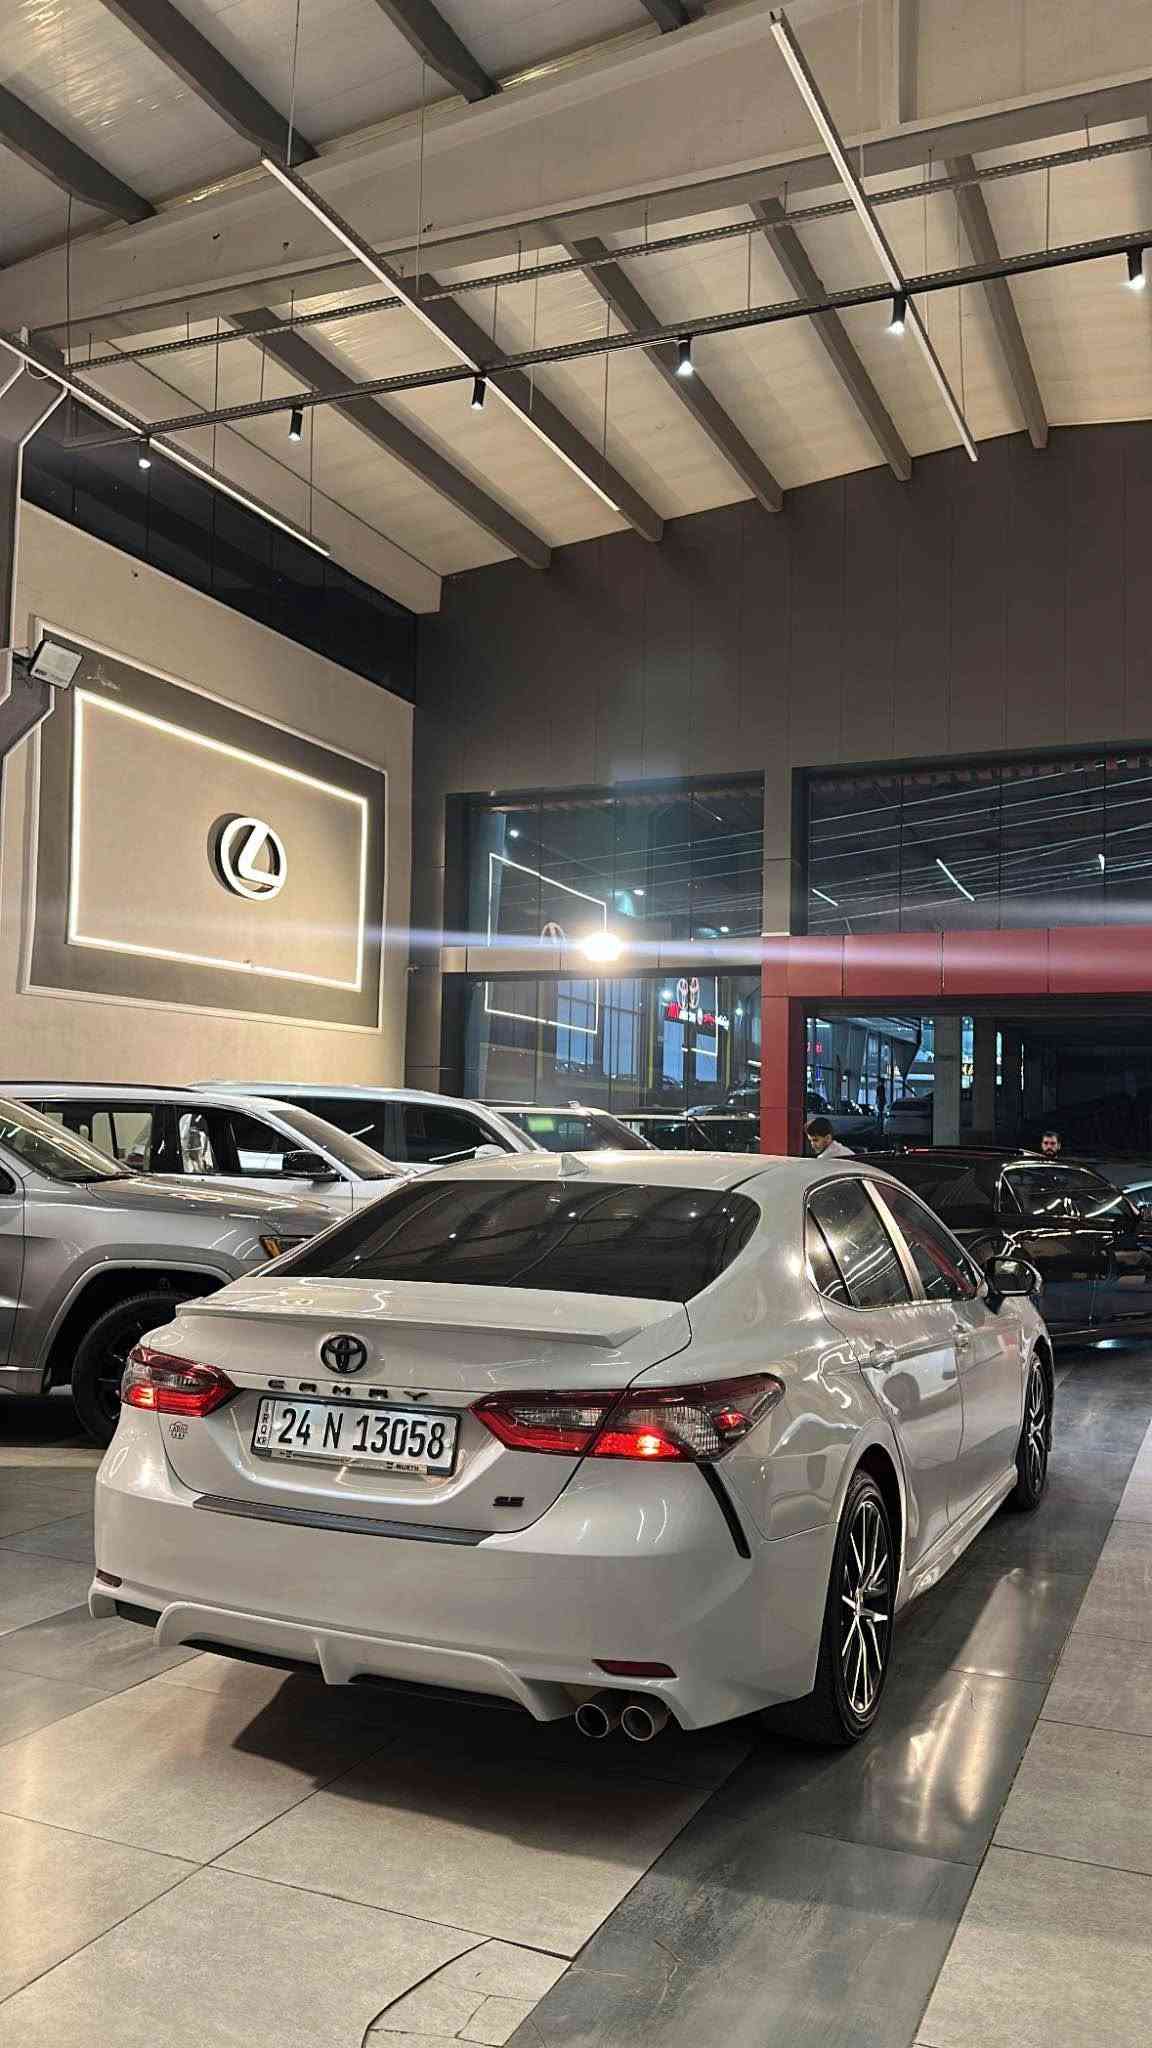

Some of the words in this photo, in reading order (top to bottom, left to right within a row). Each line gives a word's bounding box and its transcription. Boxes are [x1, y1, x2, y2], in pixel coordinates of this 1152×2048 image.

[267, 1379, 429, 1400] CAMRY
[278, 1407, 311, 1446] 24
[323, 1411, 344, 1449] N
[352, 1415, 446, 1459] 13058
